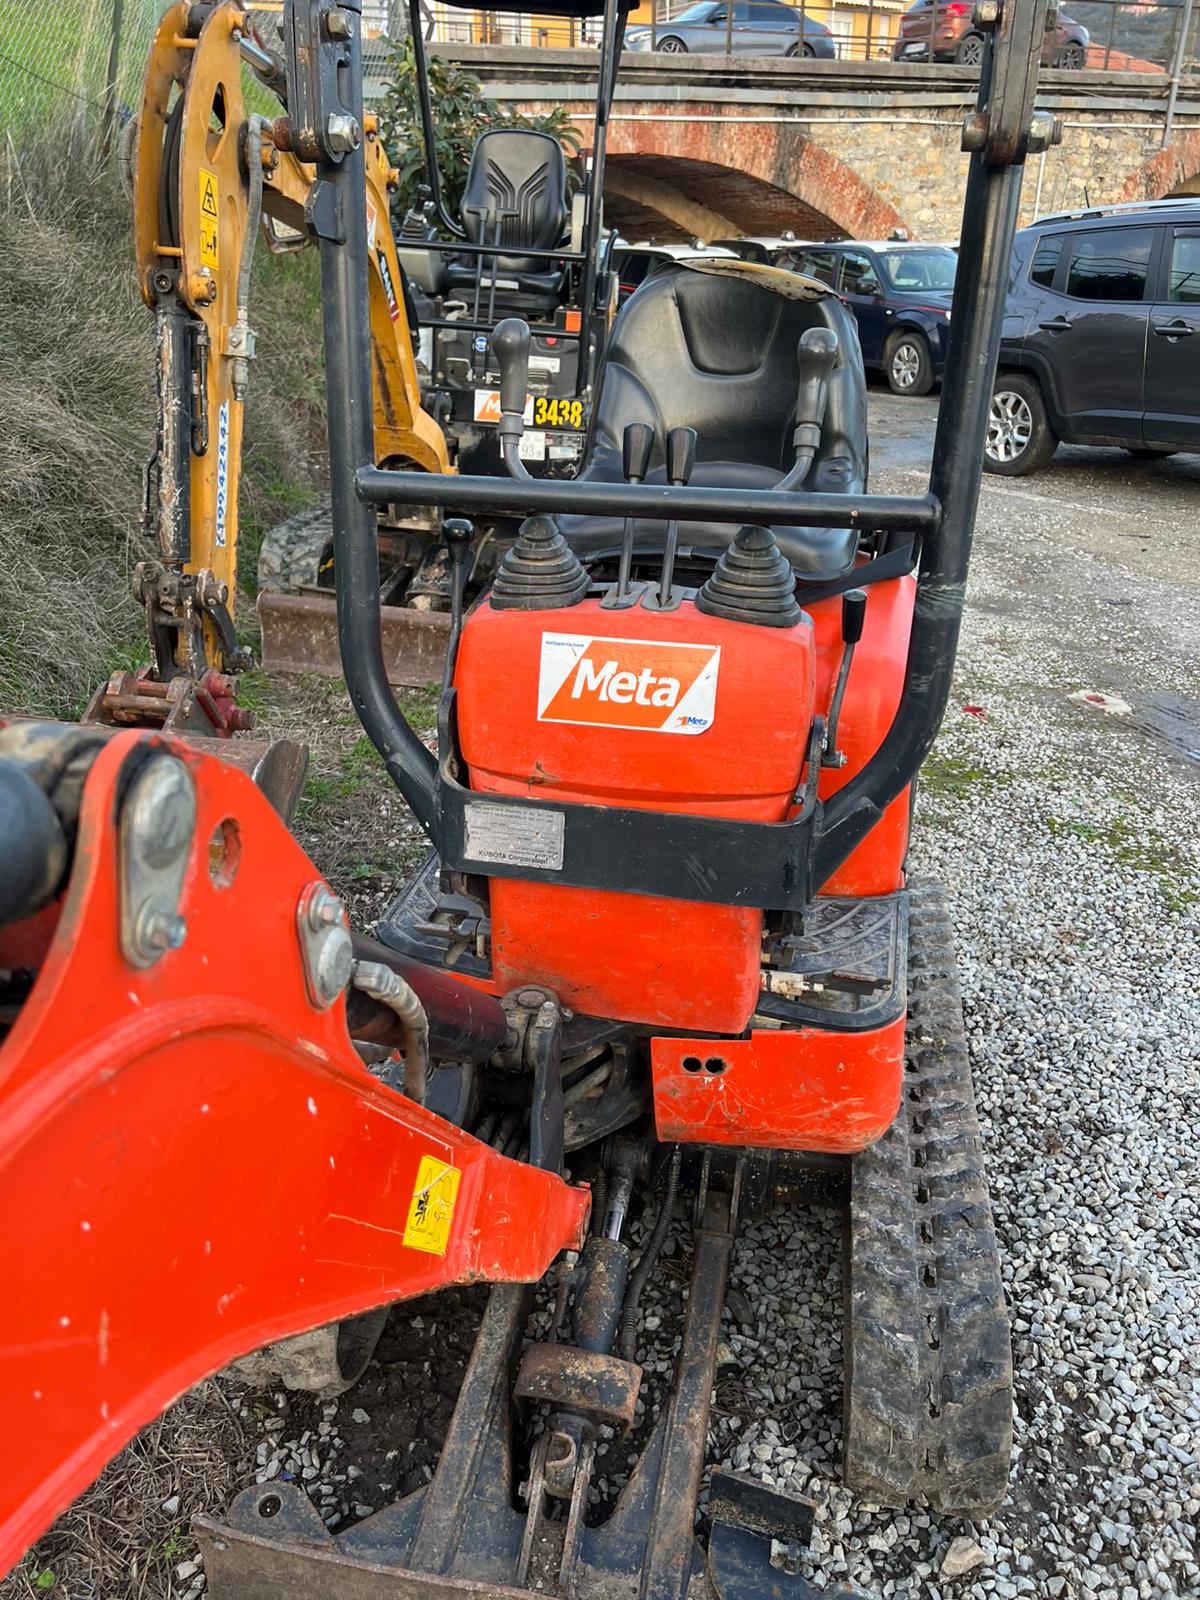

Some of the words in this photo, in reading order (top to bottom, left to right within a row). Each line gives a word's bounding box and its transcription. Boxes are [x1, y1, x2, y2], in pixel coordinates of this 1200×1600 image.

[535, 398, 583, 428] 3438
[571, 658, 681, 708] Meta
[478, 850, 508, 859] KUBOTA
[508, 854, 549, 865] Corporation
